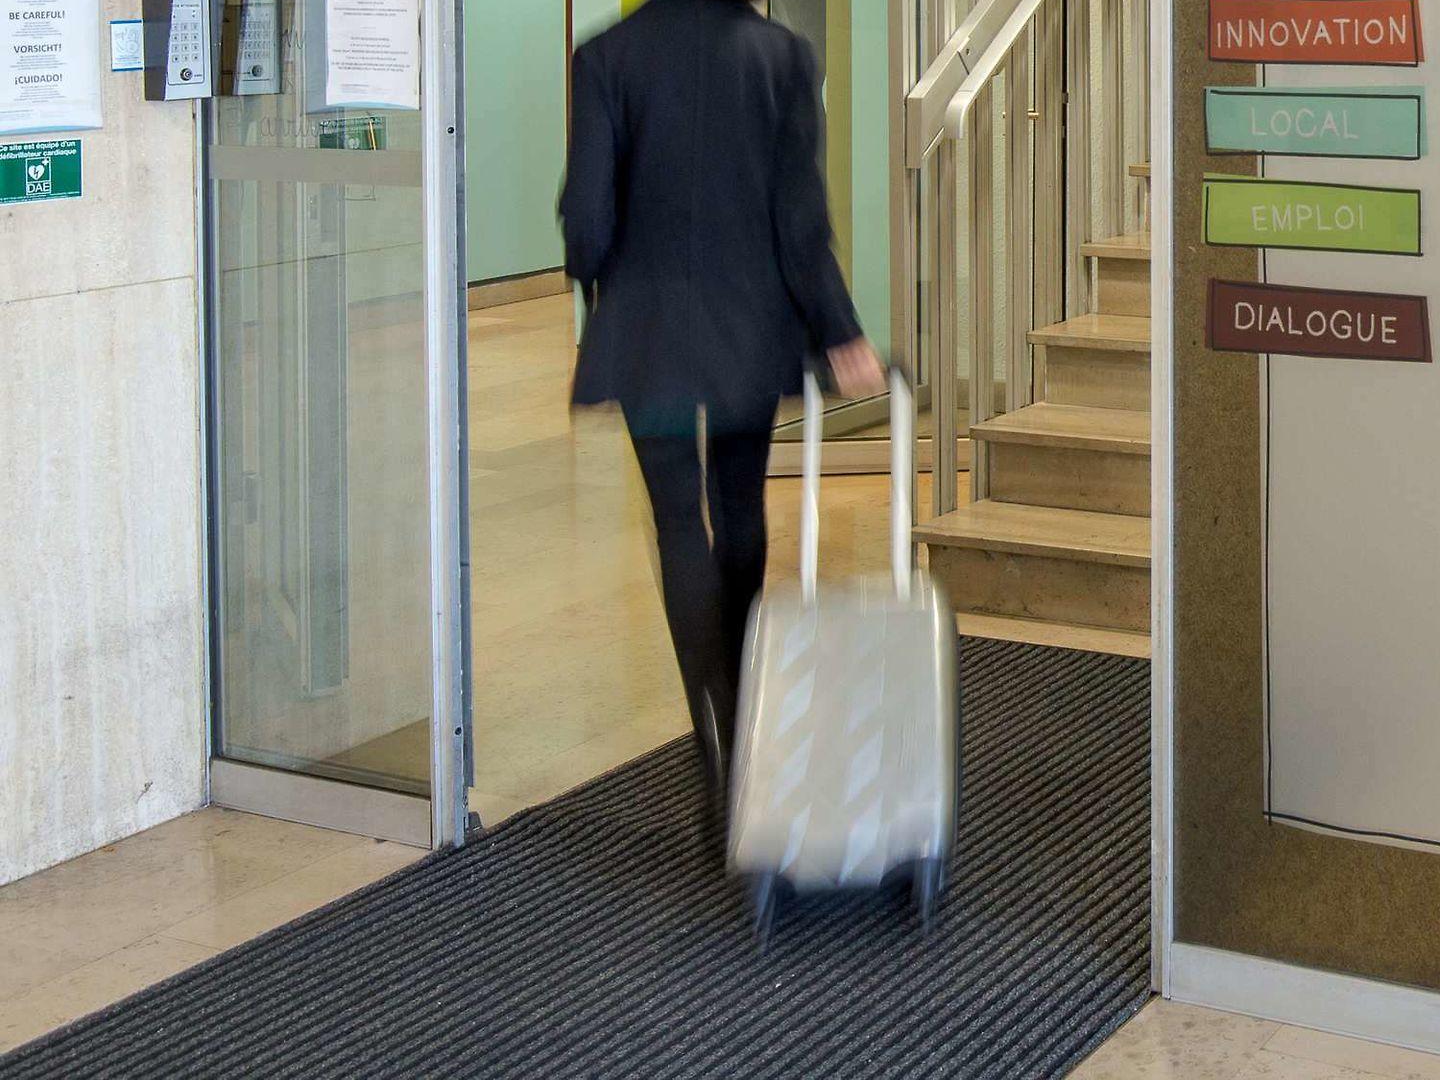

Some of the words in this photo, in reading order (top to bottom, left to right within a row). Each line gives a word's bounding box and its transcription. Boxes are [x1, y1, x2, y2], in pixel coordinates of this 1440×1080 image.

[9, 12, 20, 20] BE
[23, 11, 65, 19] CAREFUL!
[1216, 15, 1408, 49] INNOVATION
[14, 44, 61, 53] VORSICHT!
[1249, 107, 1359, 140] LOCAL
[28, 182, 50, 193] DAE
[1251, 204, 1366, 231] EMPLOI
[1233, 302, 1398, 344] DIALOGUE
